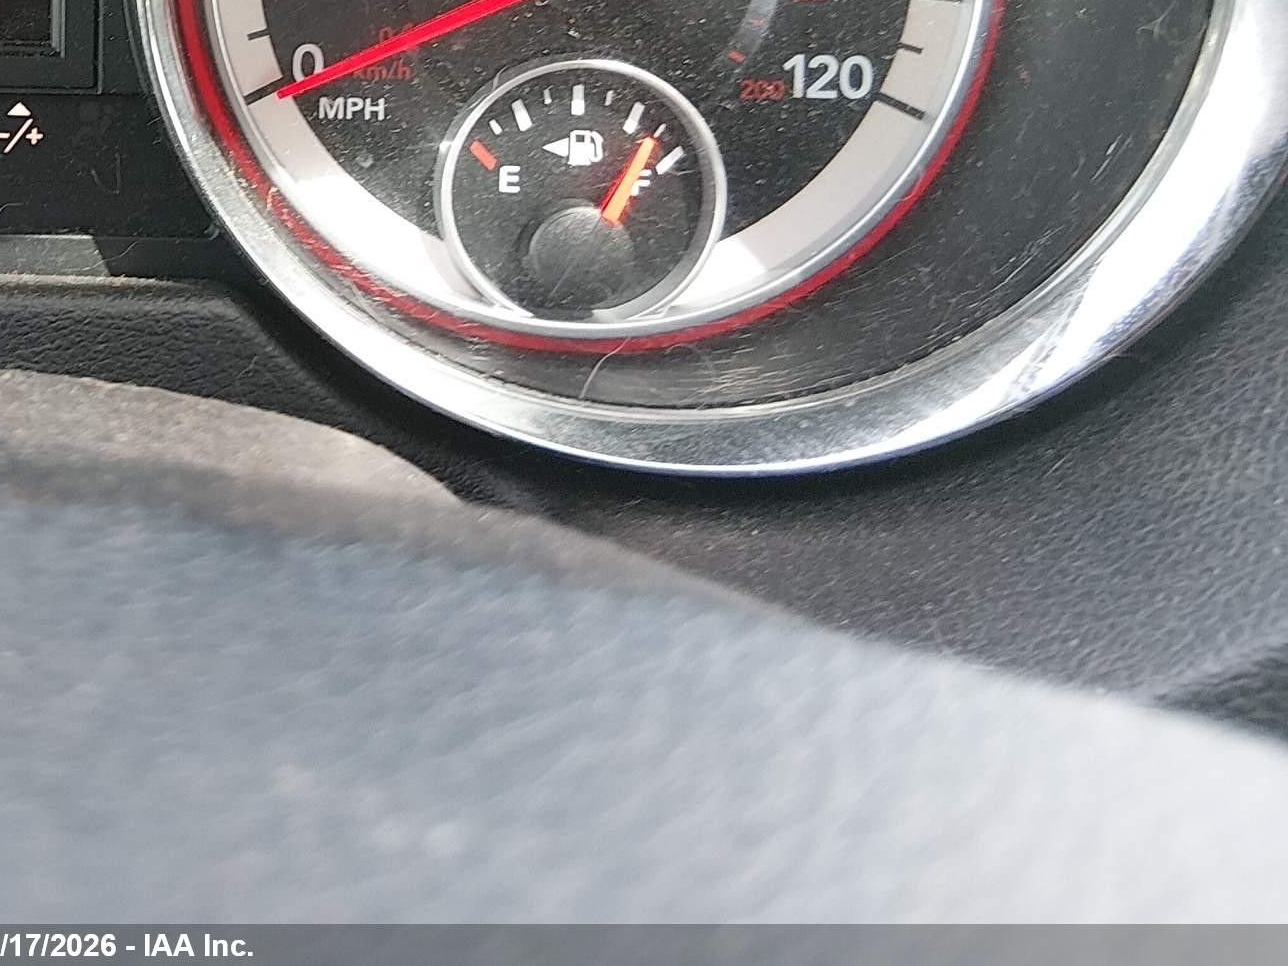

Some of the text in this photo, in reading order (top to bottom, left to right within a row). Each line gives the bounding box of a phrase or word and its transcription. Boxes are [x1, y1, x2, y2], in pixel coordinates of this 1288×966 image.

[292, 43, 325, 85] 0
[783, 54, 873, 100] 120
[318, 96, 386, 121] MPH
[498, 165, 521, 194] E
